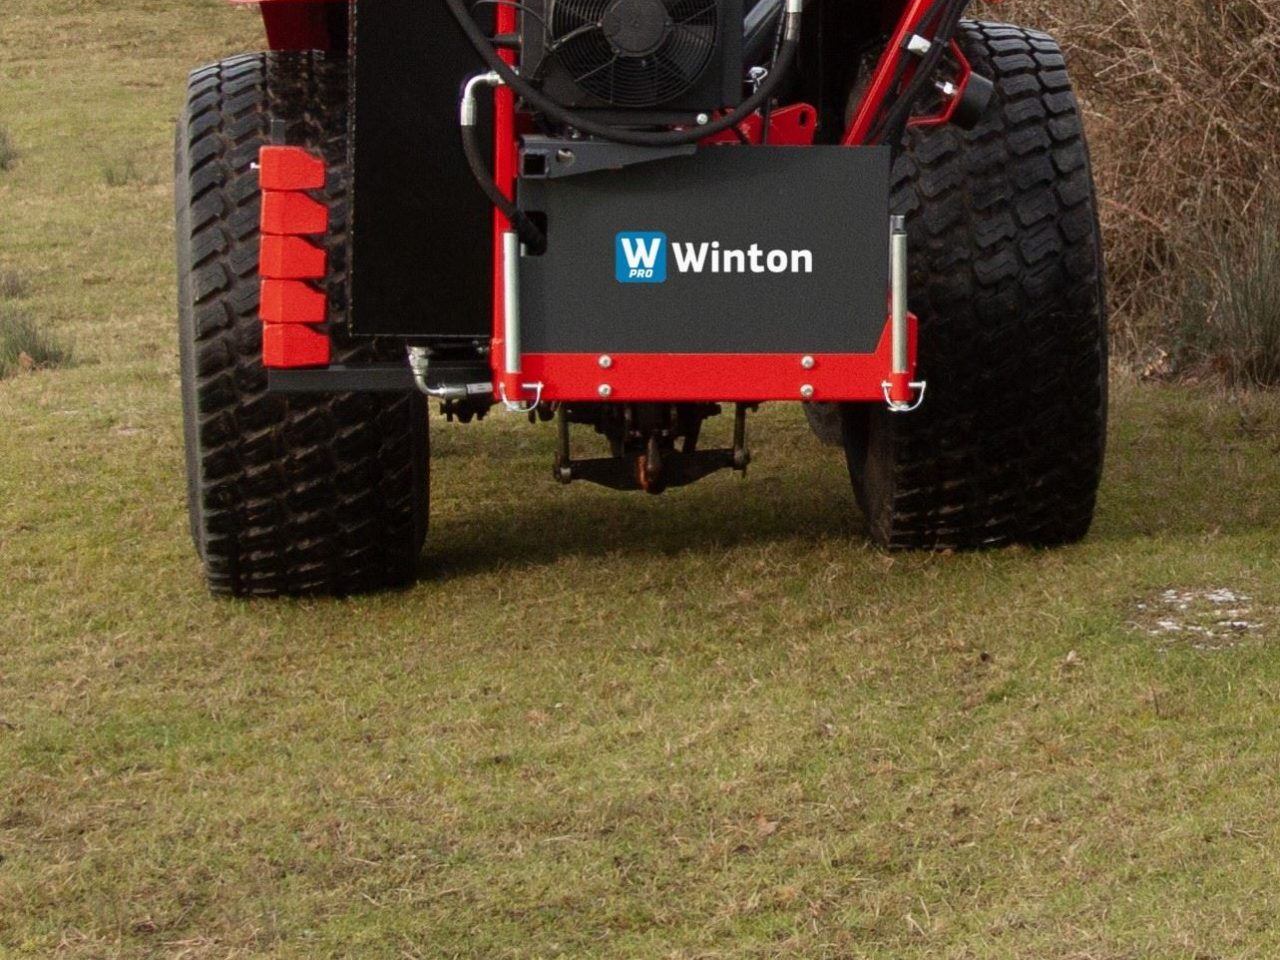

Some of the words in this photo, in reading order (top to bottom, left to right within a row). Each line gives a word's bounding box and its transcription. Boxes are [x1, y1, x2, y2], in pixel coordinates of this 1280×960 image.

[621, 238, 661, 268] W
[671, 241, 813, 273] Winton
[629, 269, 654, 279] PRO
